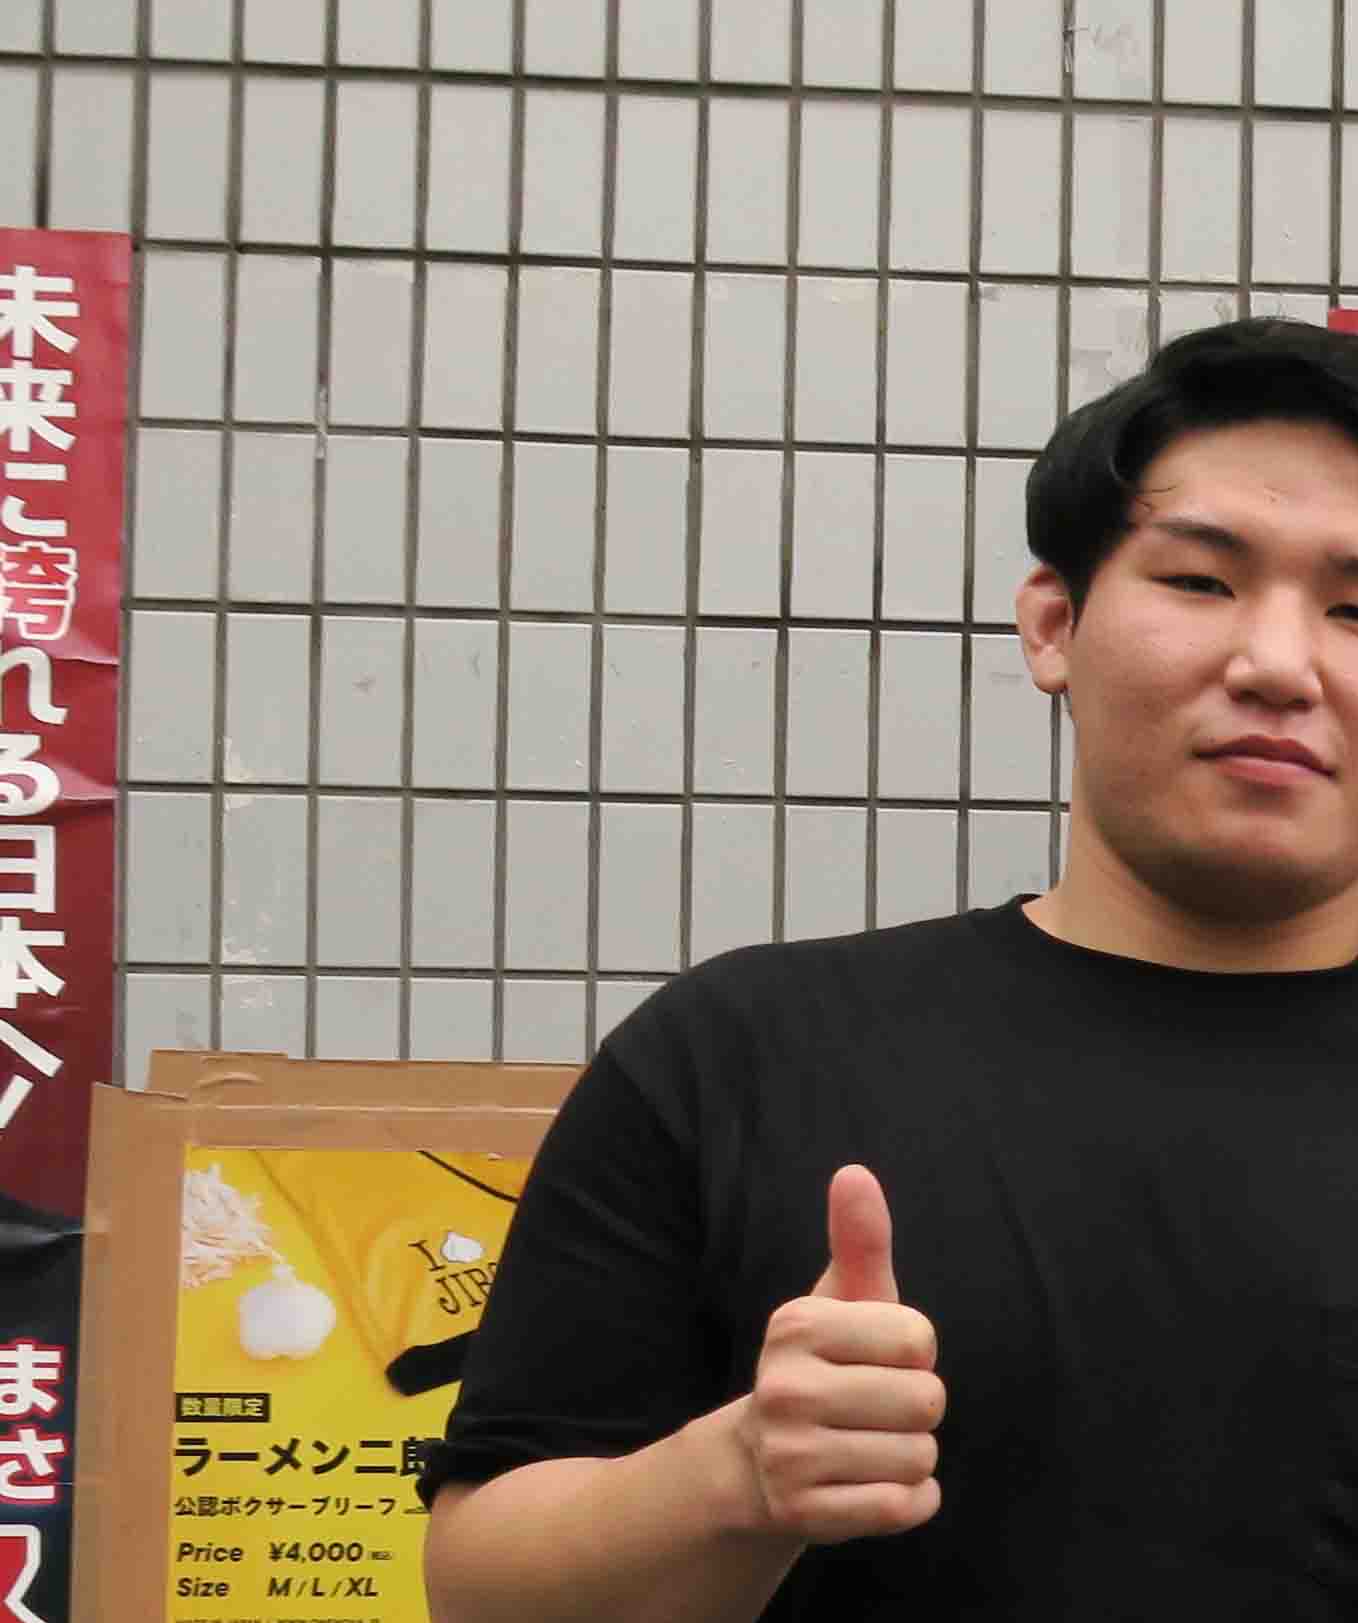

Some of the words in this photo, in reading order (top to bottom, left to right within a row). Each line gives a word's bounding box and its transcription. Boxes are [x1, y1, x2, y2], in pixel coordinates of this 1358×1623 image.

[435, 1262, 497, 1315] JIR
[176, 1541, 245, 1563] Price
[268, 1541, 364, 1565] ¥4,000
[176, 1576, 230, 1598] Size
